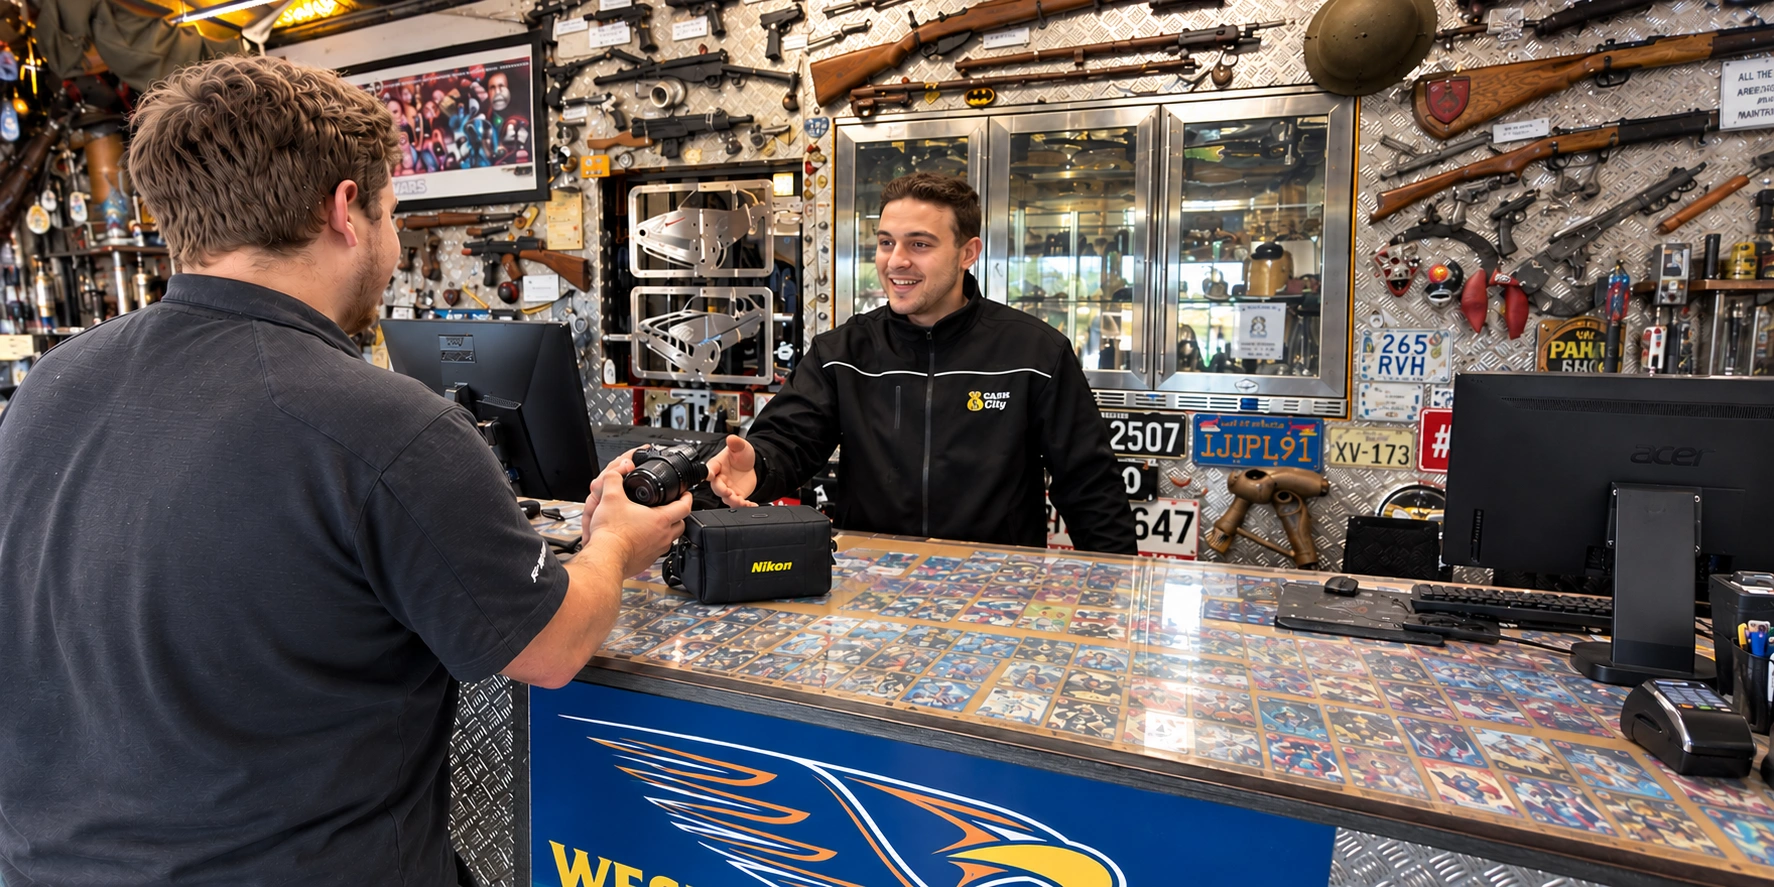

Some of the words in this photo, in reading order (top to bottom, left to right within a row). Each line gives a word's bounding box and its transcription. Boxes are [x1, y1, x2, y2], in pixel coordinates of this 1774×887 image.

[1738, 72, 1754, 82] ALL
[1757, 69, 1773, 80] THE
[1382, 334, 1427, 355] 265
[1378, 355, 1425, 376] RVH
[1110, 420, 1180, 453] 2507
[1335, 441, 1410, 465] XV-173
[1630, 444, 1716, 467] acer
[1133, 507, 1195, 545] 647
[751, 560, 793, 573] Nikon
